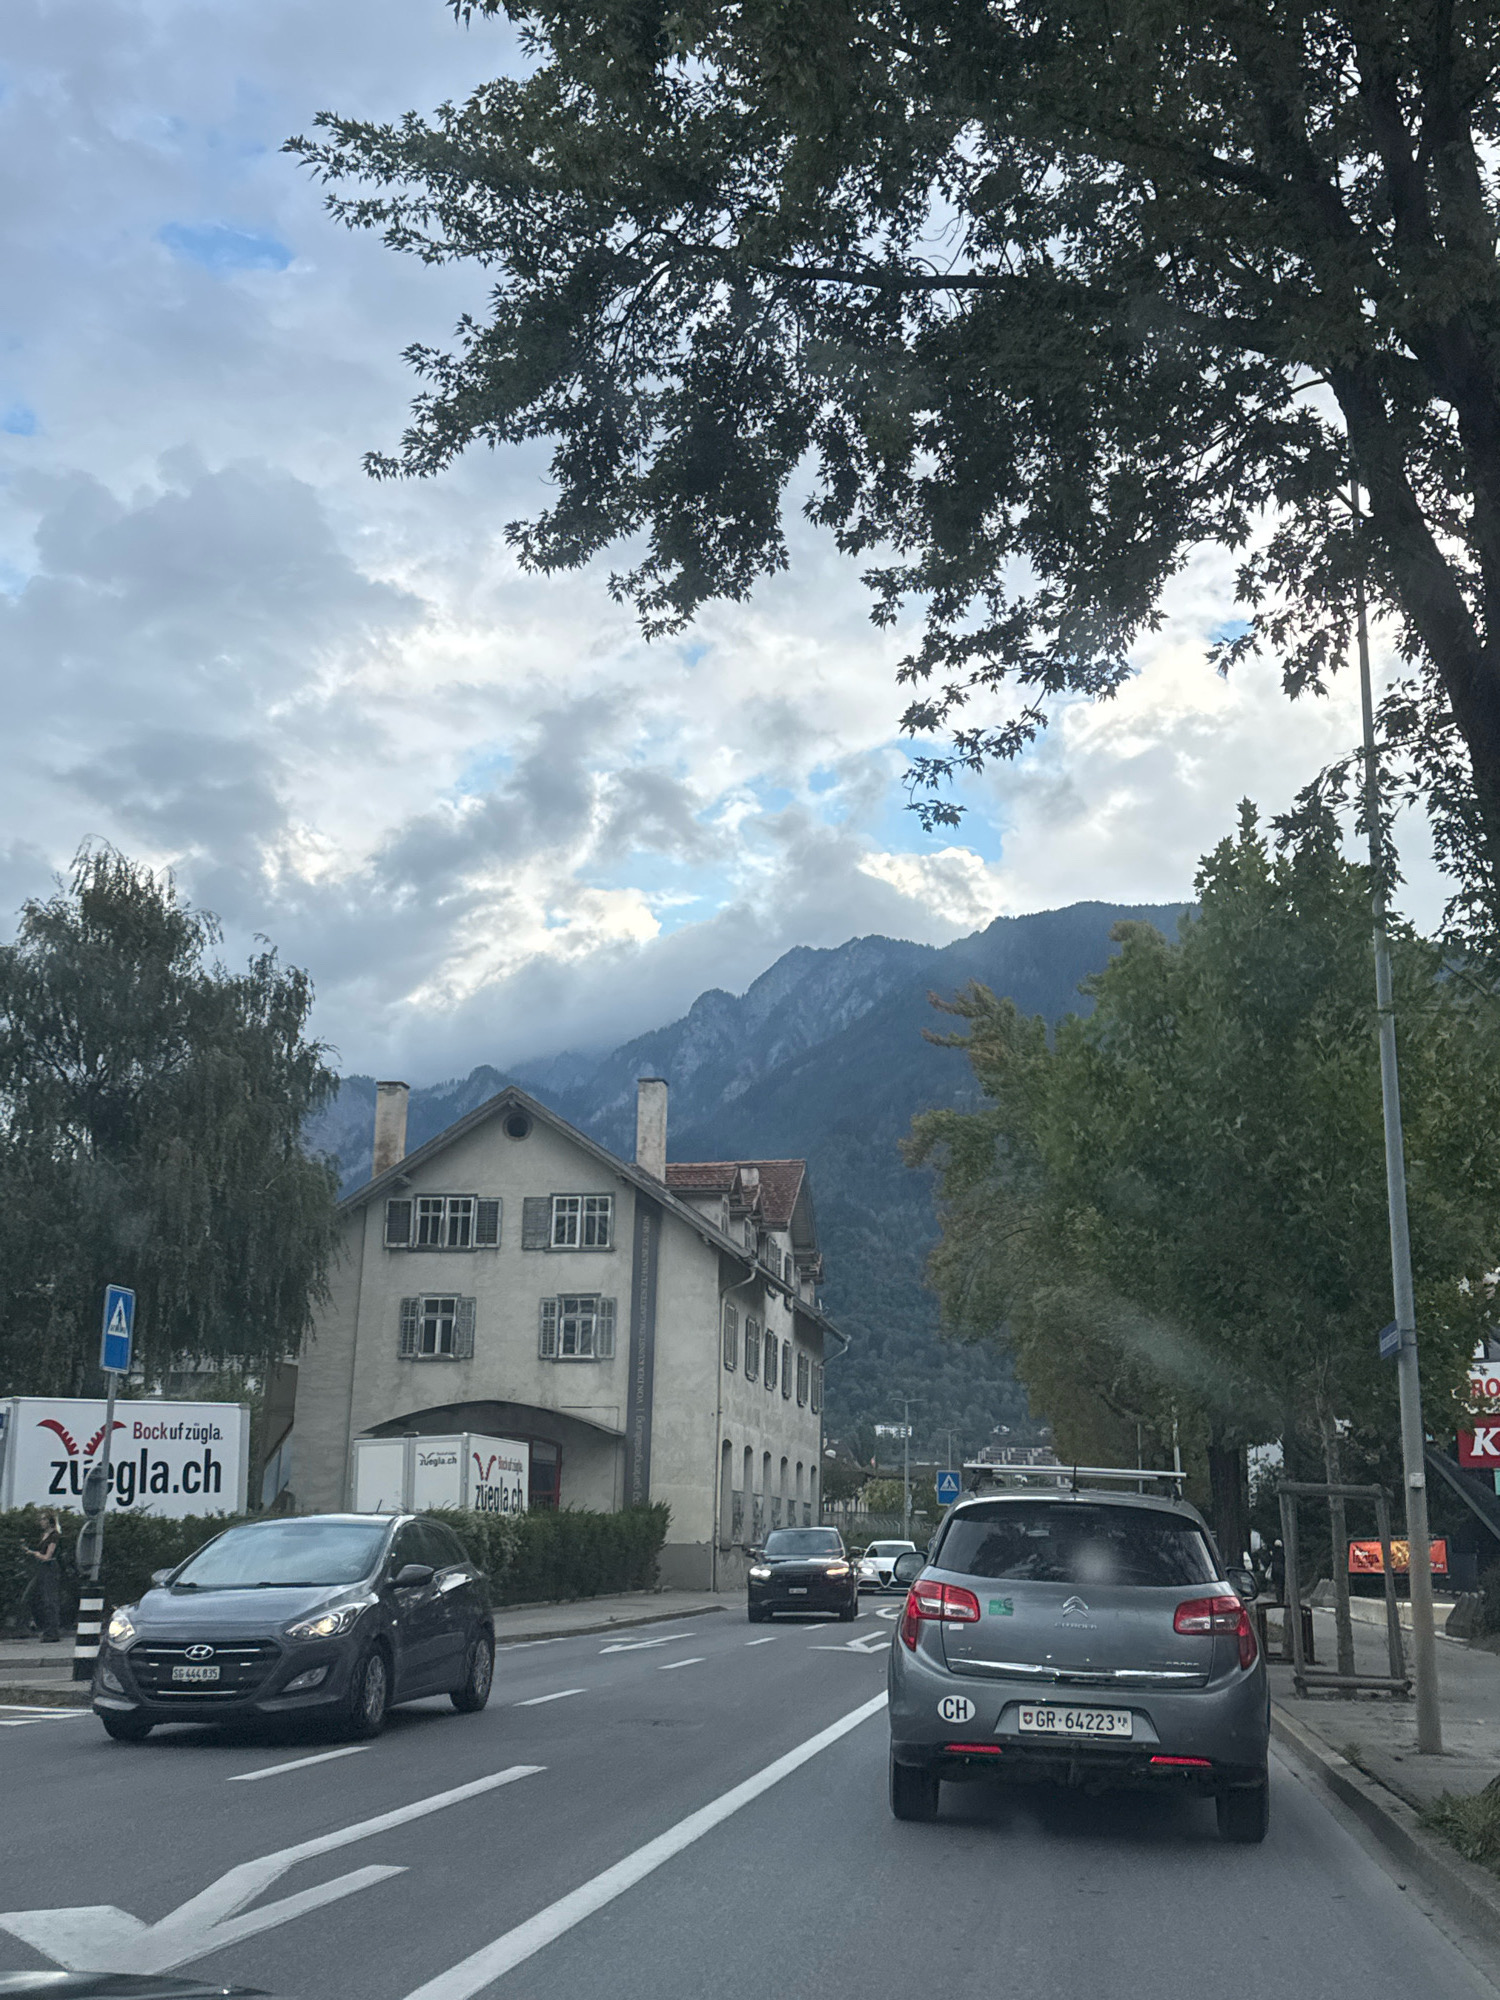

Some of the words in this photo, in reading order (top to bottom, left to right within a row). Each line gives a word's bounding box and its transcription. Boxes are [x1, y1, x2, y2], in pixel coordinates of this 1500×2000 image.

[640, 1275, 648, 1286] ZU
[639, 1288, 648, 1322] GARTEN
[637, 1366, 645, 1384] DER
[635, 1385, 644, 1404] VON
[133, 1421, 168, 1440] Bock
[169, 1422, 184, 1440] uf
[632, 1415, 646, 1490] gartengestaltung
[943, 1698, 968, 1719] CH
